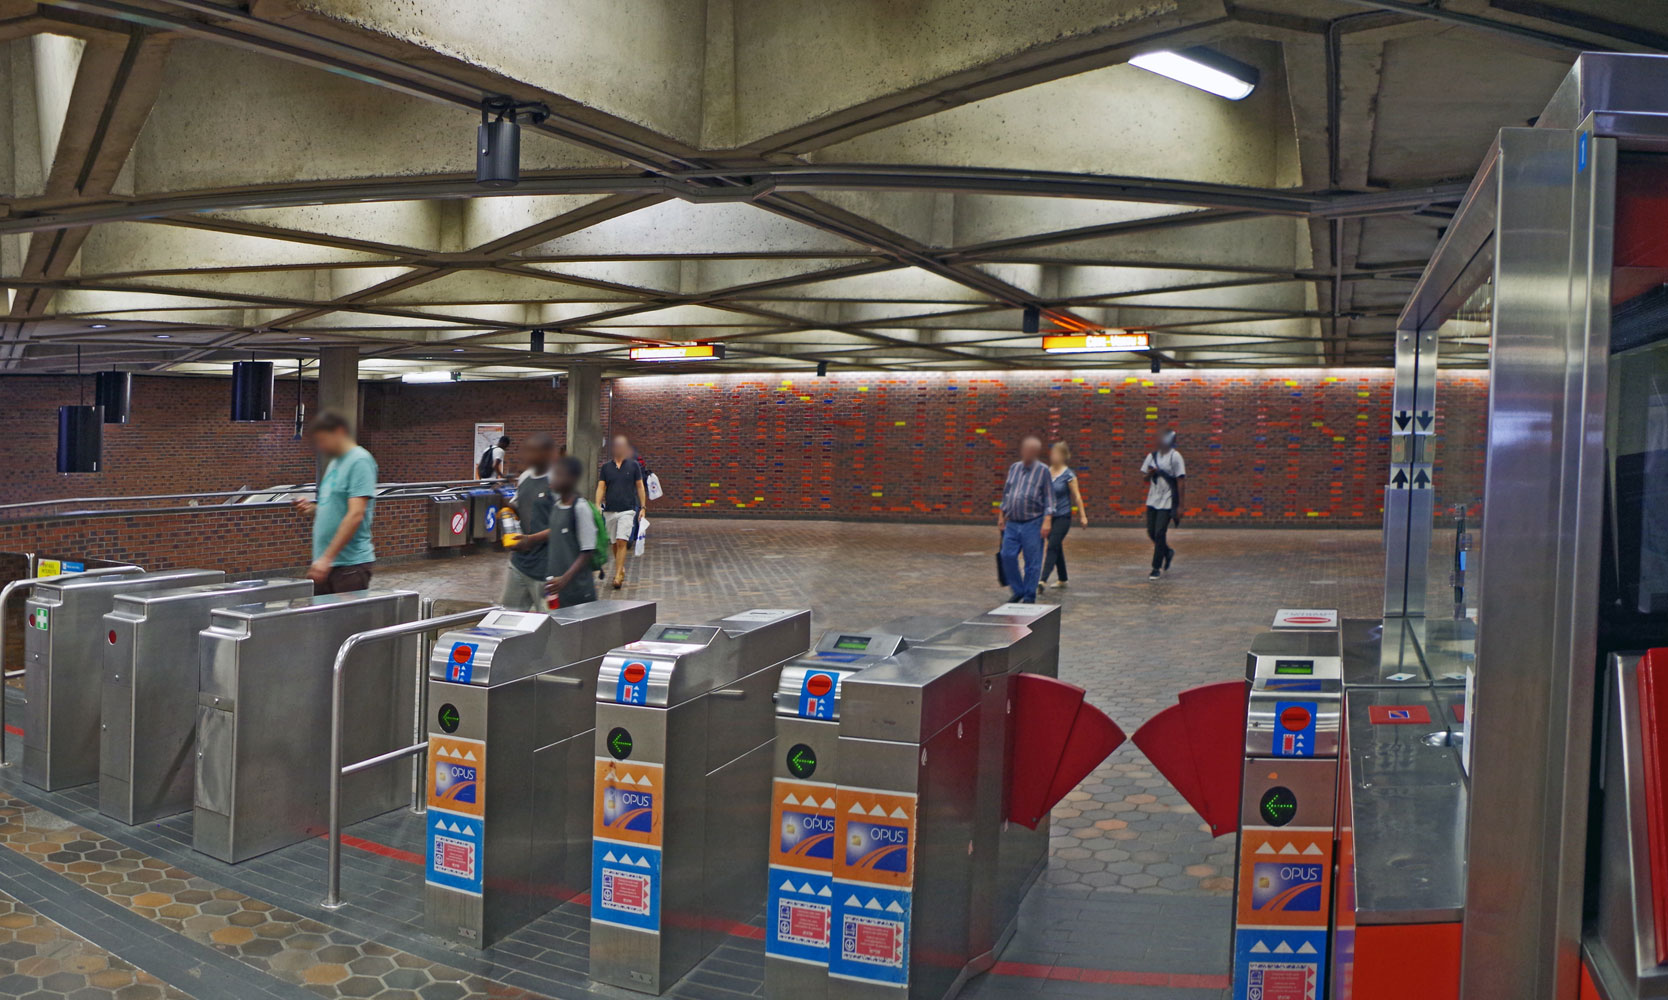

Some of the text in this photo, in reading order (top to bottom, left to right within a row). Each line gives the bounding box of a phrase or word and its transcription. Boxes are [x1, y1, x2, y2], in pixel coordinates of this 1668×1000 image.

[451, 766, 474, 780] OPUS
[622, 793, 649, 807] OPUS
[803, 817, 834, 832] OPUS
[870, 827, 904, 843] OPUS
[1280, 867, 1318, 880] OPUS
